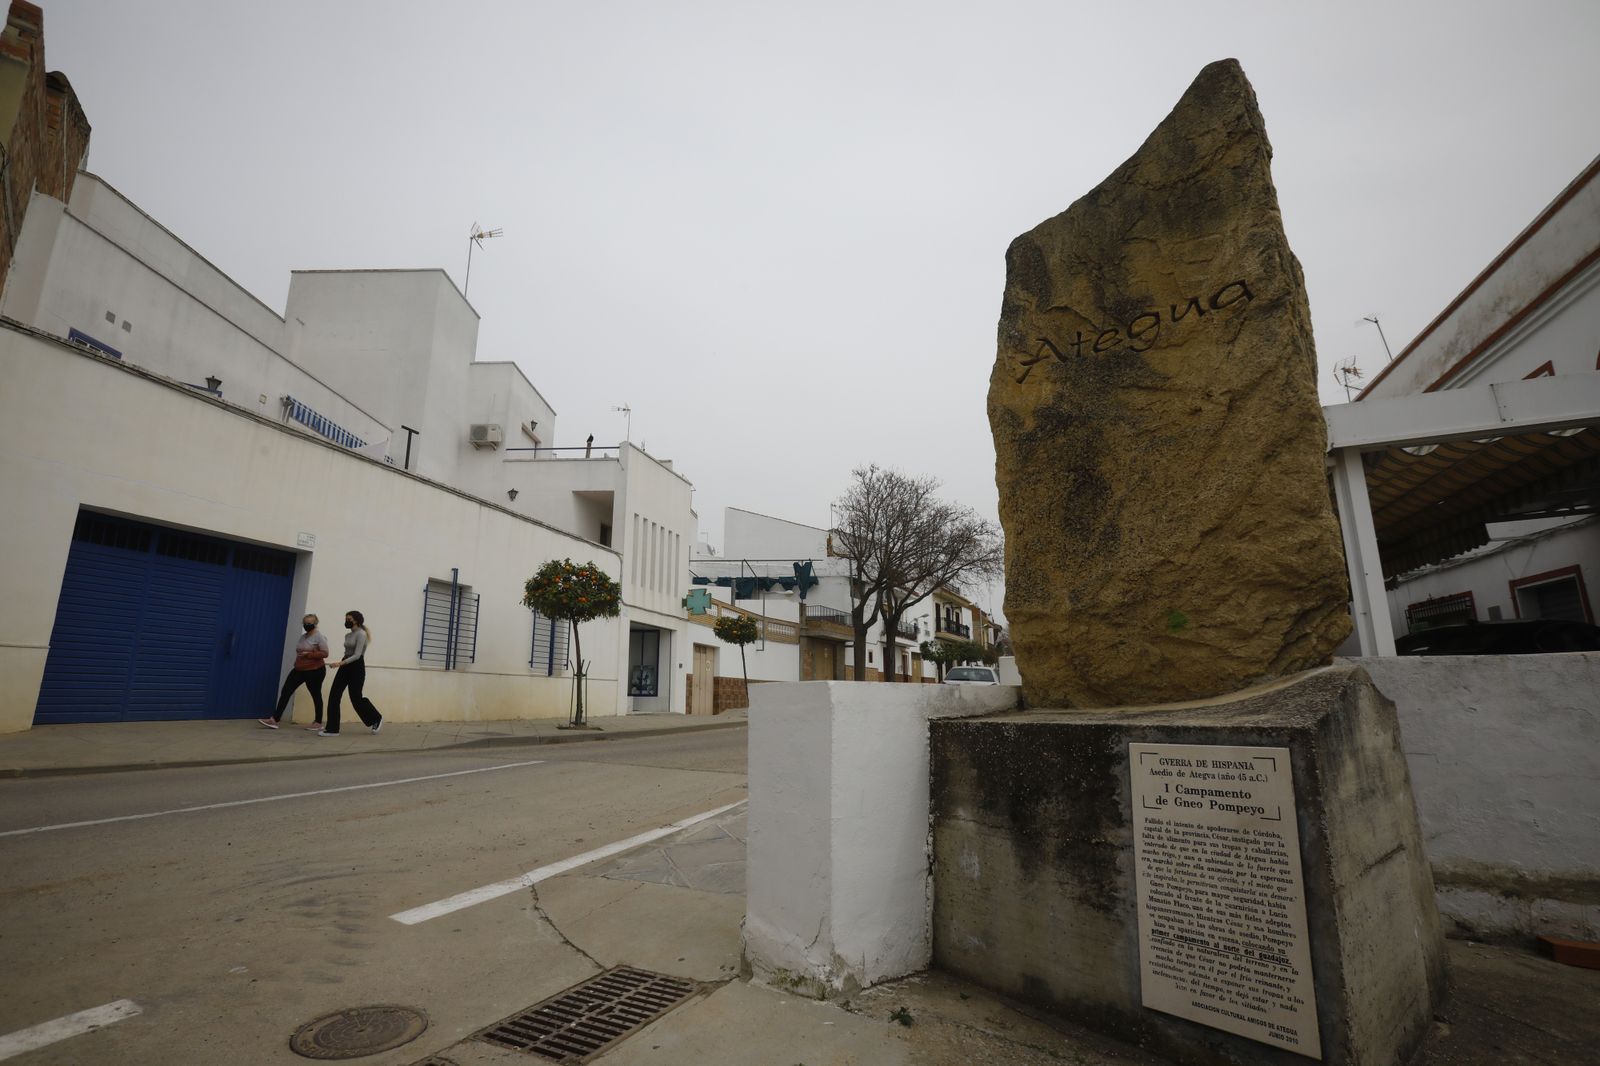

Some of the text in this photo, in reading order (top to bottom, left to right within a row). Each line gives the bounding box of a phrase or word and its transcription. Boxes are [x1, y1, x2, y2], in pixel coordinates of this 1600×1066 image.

[1016, 279, 1255, 385] Ategua
[1158, 757, 1255, 771] GVERRA DE HISPANIA
[1149, 767, 1268, 783] Asedio de Ategva (año 45 a.C.)
[1164, 783, 1252, 800] I Campamento
[1155, 794, 1265, 816] de Gneo Pompeyo
[1220, 1008, 1246, 1022] CULTURAL
[1246, 1016, 1267, 1027] AMIGOS
[1267, 1022, 1276, 1030] DE
[1276, 1024, 1298, 1037] ATEGUA
[1268, 1030, 1285, 1041] JUNIO
